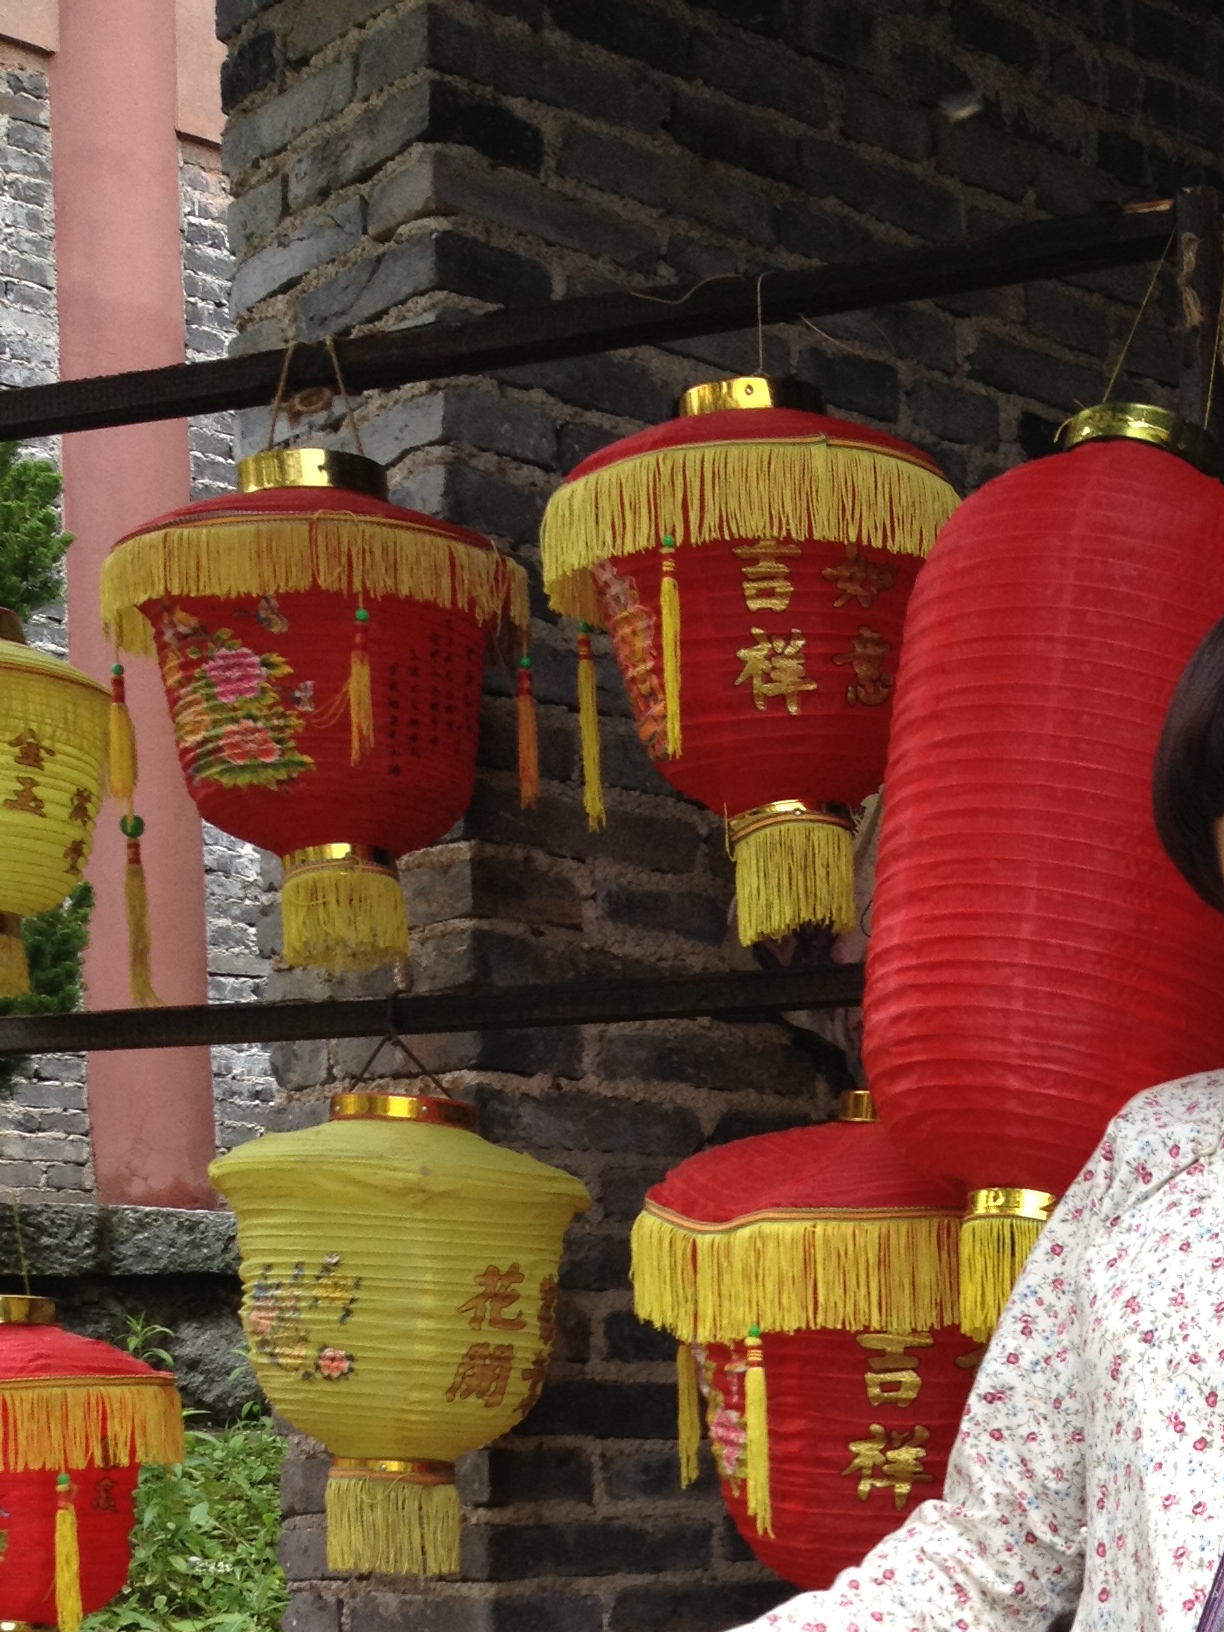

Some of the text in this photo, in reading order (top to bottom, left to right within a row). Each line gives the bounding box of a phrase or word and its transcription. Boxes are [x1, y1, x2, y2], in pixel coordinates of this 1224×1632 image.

[732, 540, 818, 716] 吉祥
[821, 542, 899, 707] 如意
[3, 728, 56, 819] 金玉
[446, 1262, 528, 1409] 花開
[841, 1332, 935, 1511] 吉祥
